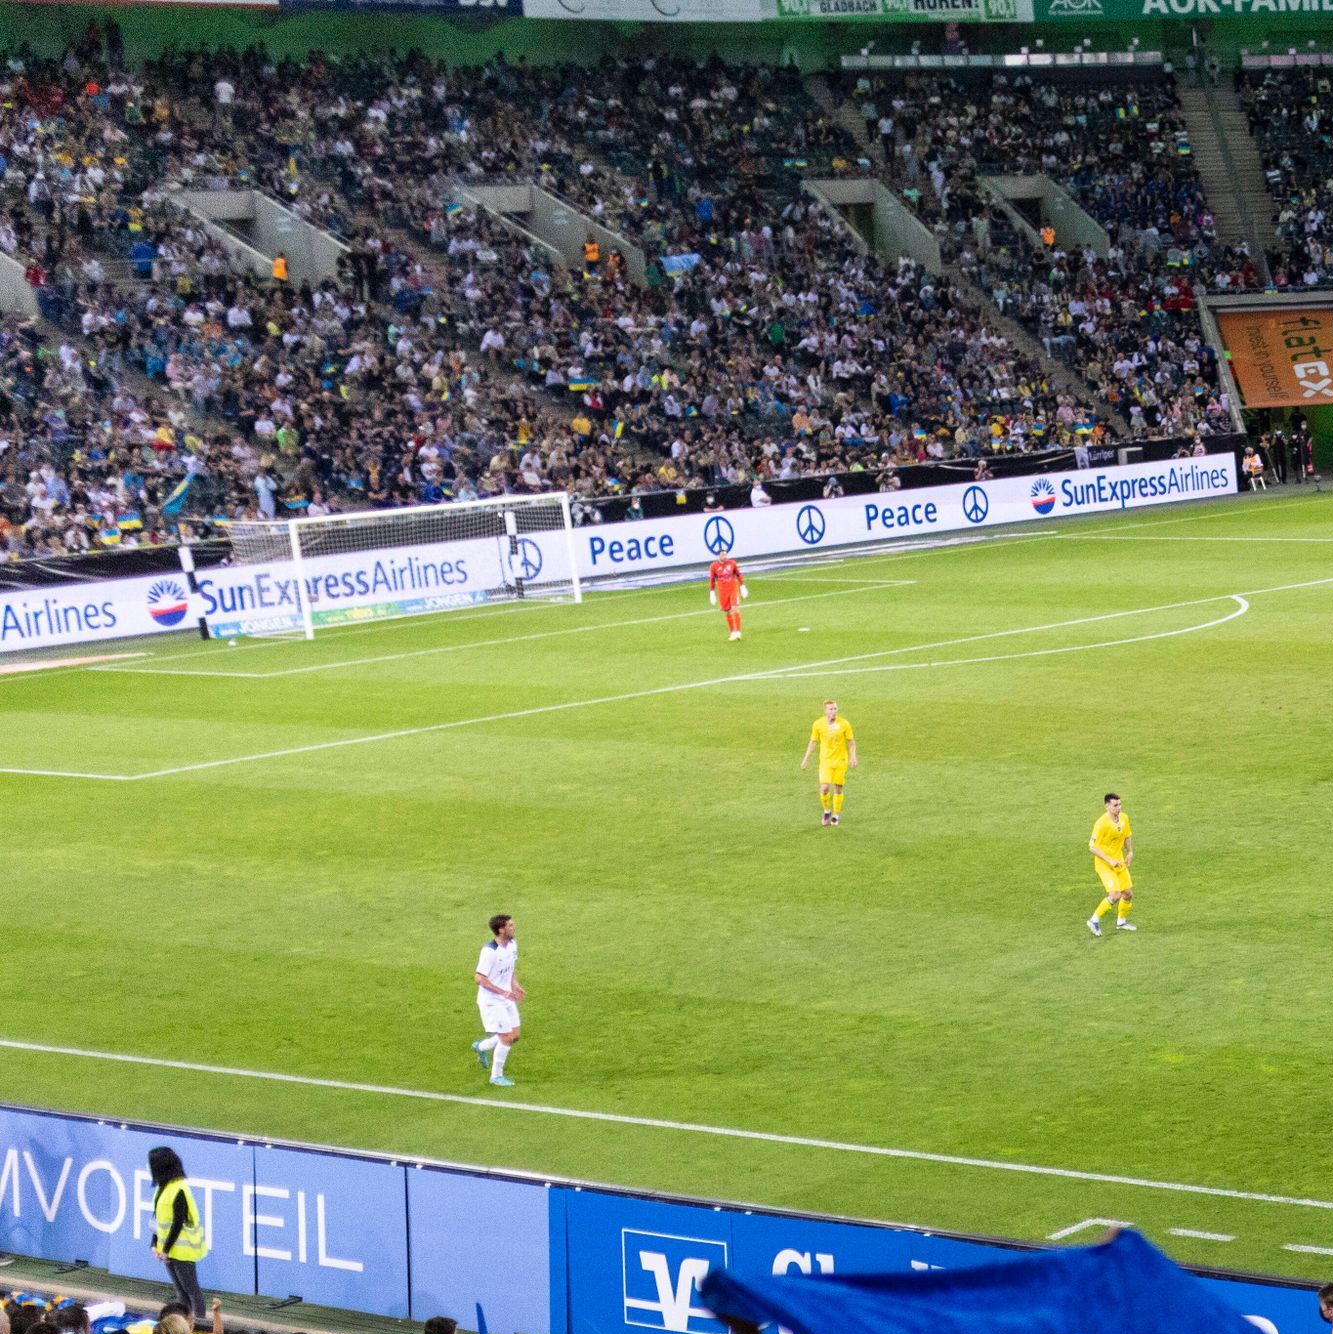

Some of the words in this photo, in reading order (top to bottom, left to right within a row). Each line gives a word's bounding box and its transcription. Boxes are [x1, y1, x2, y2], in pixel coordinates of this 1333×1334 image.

[1061, 466, 1229, 508] SunExpressAirlines
[865, 501, 937, 530] Peace
[589, 532, 674, 567] Peace
[1, 600, 117, 640] Airlines
